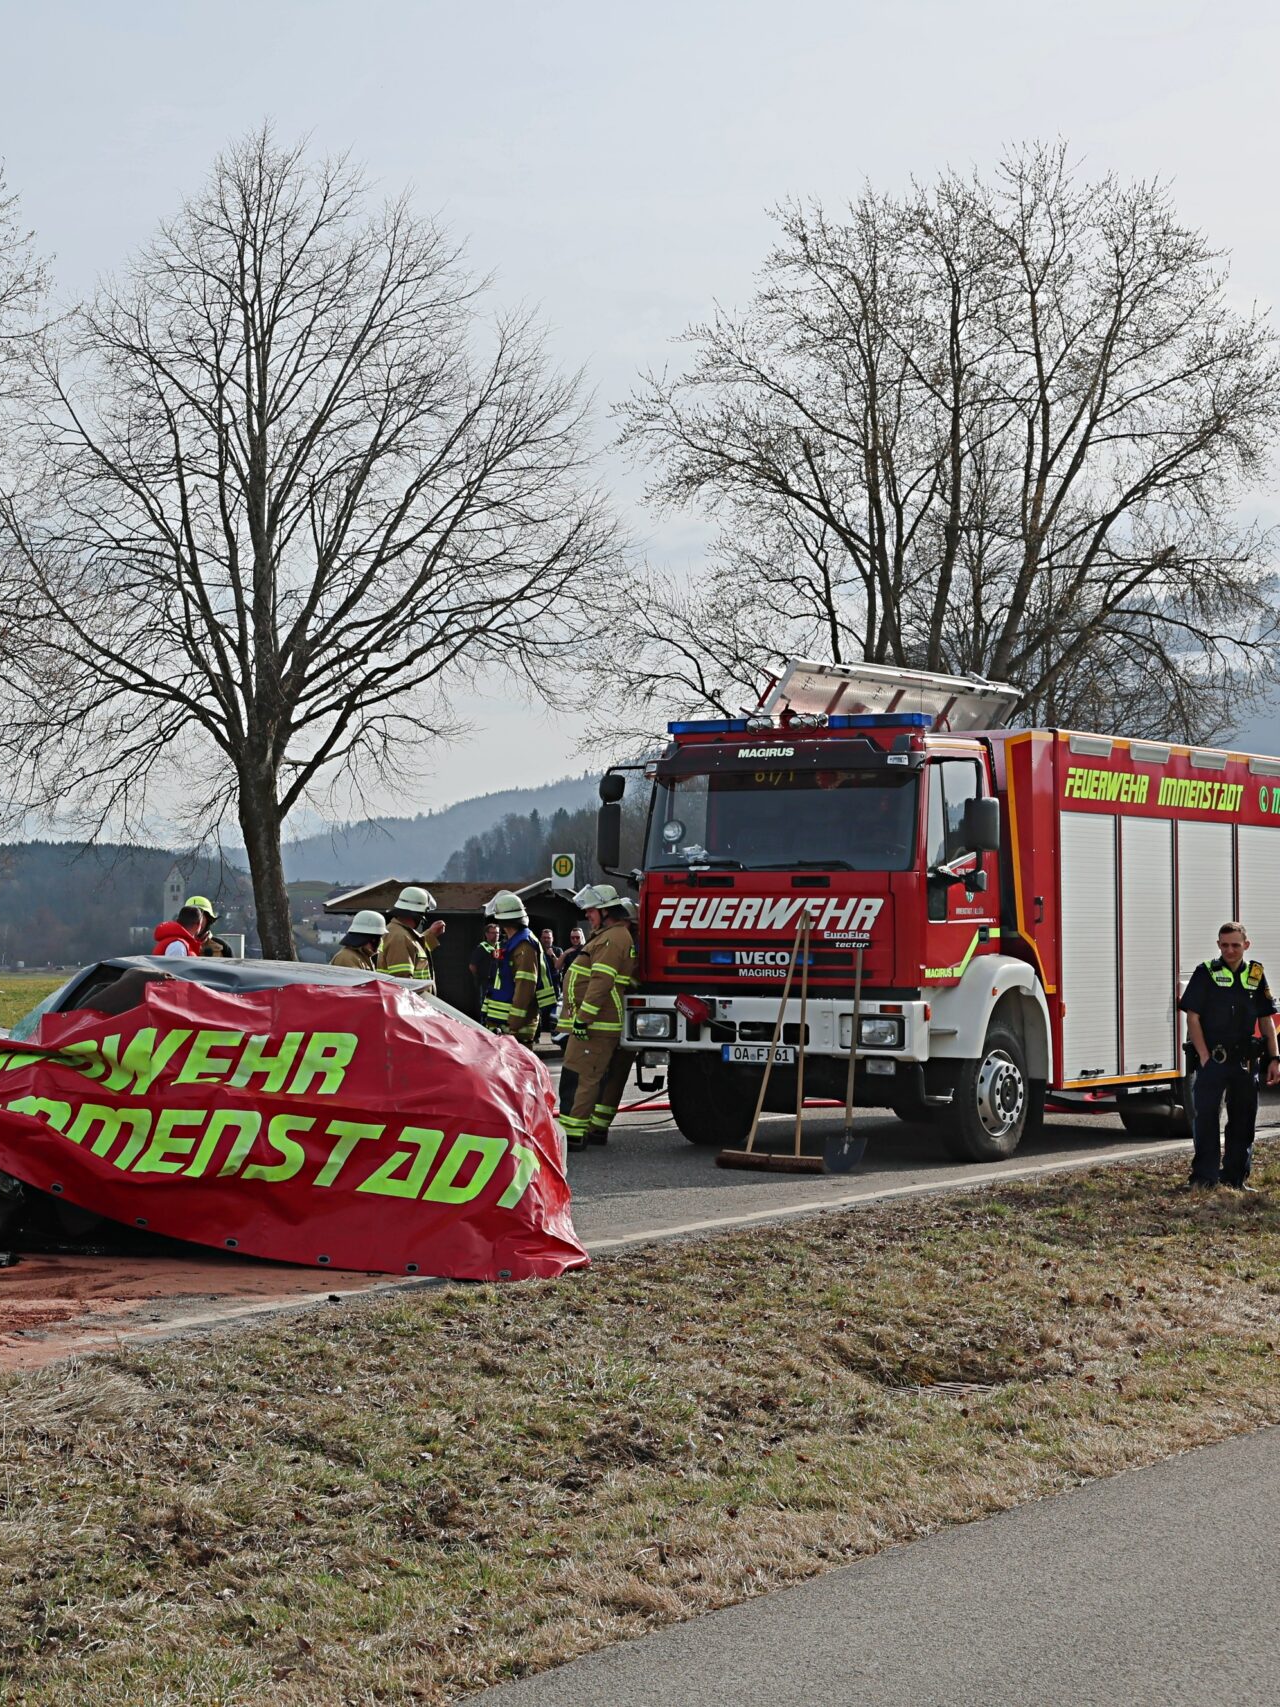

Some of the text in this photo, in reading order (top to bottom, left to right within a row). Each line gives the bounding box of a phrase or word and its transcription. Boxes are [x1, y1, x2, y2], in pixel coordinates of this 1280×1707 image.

[738, 748, 795, 758] MAGIRUS
[1064, 767, 1150, 804] FEUERWEHR
[1157, 777, 1244, 812] IMMENSTADT
[558, 860, 568, 873] H
[652, 897, 884, 930] FEUERWEHR
[835, 941, 870, 949] tector
[735, 951, 791, 966] IVECO
[738, 968, 787, 978] MAGIRUS
[924, 967, 953, 979] MAGIRUS
[734, 1047, 750, 1061] OA
